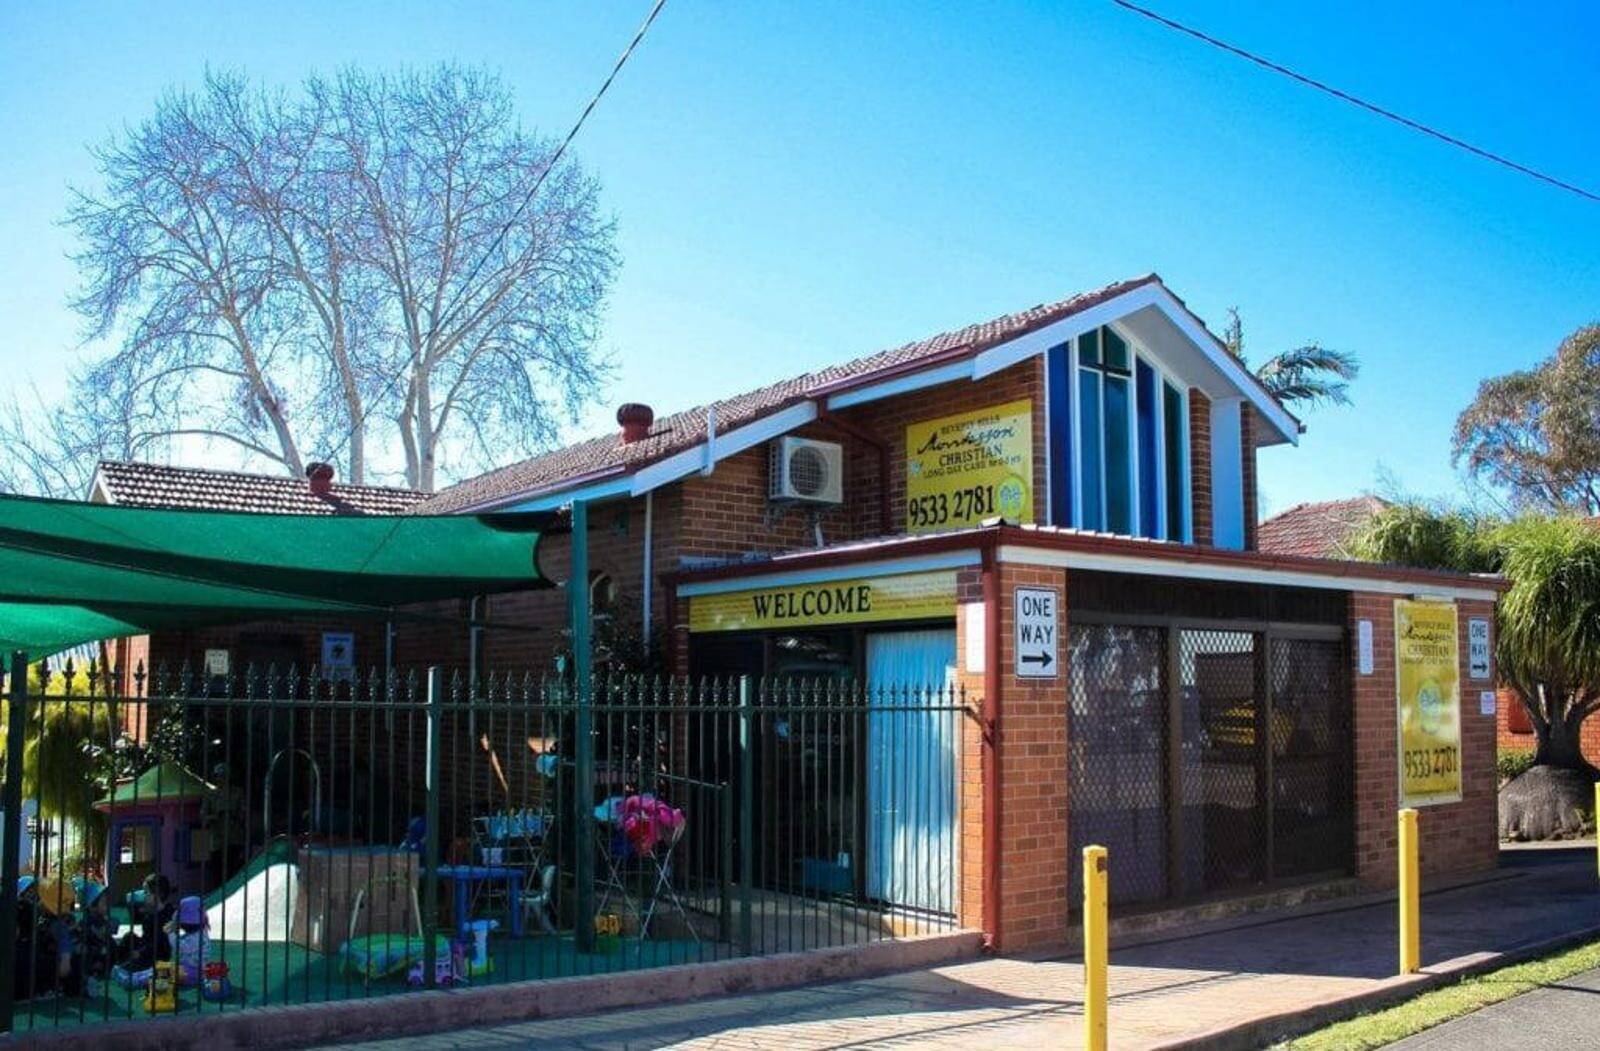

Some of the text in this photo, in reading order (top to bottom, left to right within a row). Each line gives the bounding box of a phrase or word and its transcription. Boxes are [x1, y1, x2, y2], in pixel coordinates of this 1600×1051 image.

[939, 444, 1003, 466] CHRISTIAN
[909, 485, 994, 526] 9533 2781
[752, 585, 871, 619] WELCOME
[1022, 596, 1051, 617] ONE
[1020, 624, 1053, 644] WAY
[1472, 623, 1487, 638] ONE
[1472, 644, 1487, 657] WAY
[1404, 746, 1457, 778] 9533 2781
